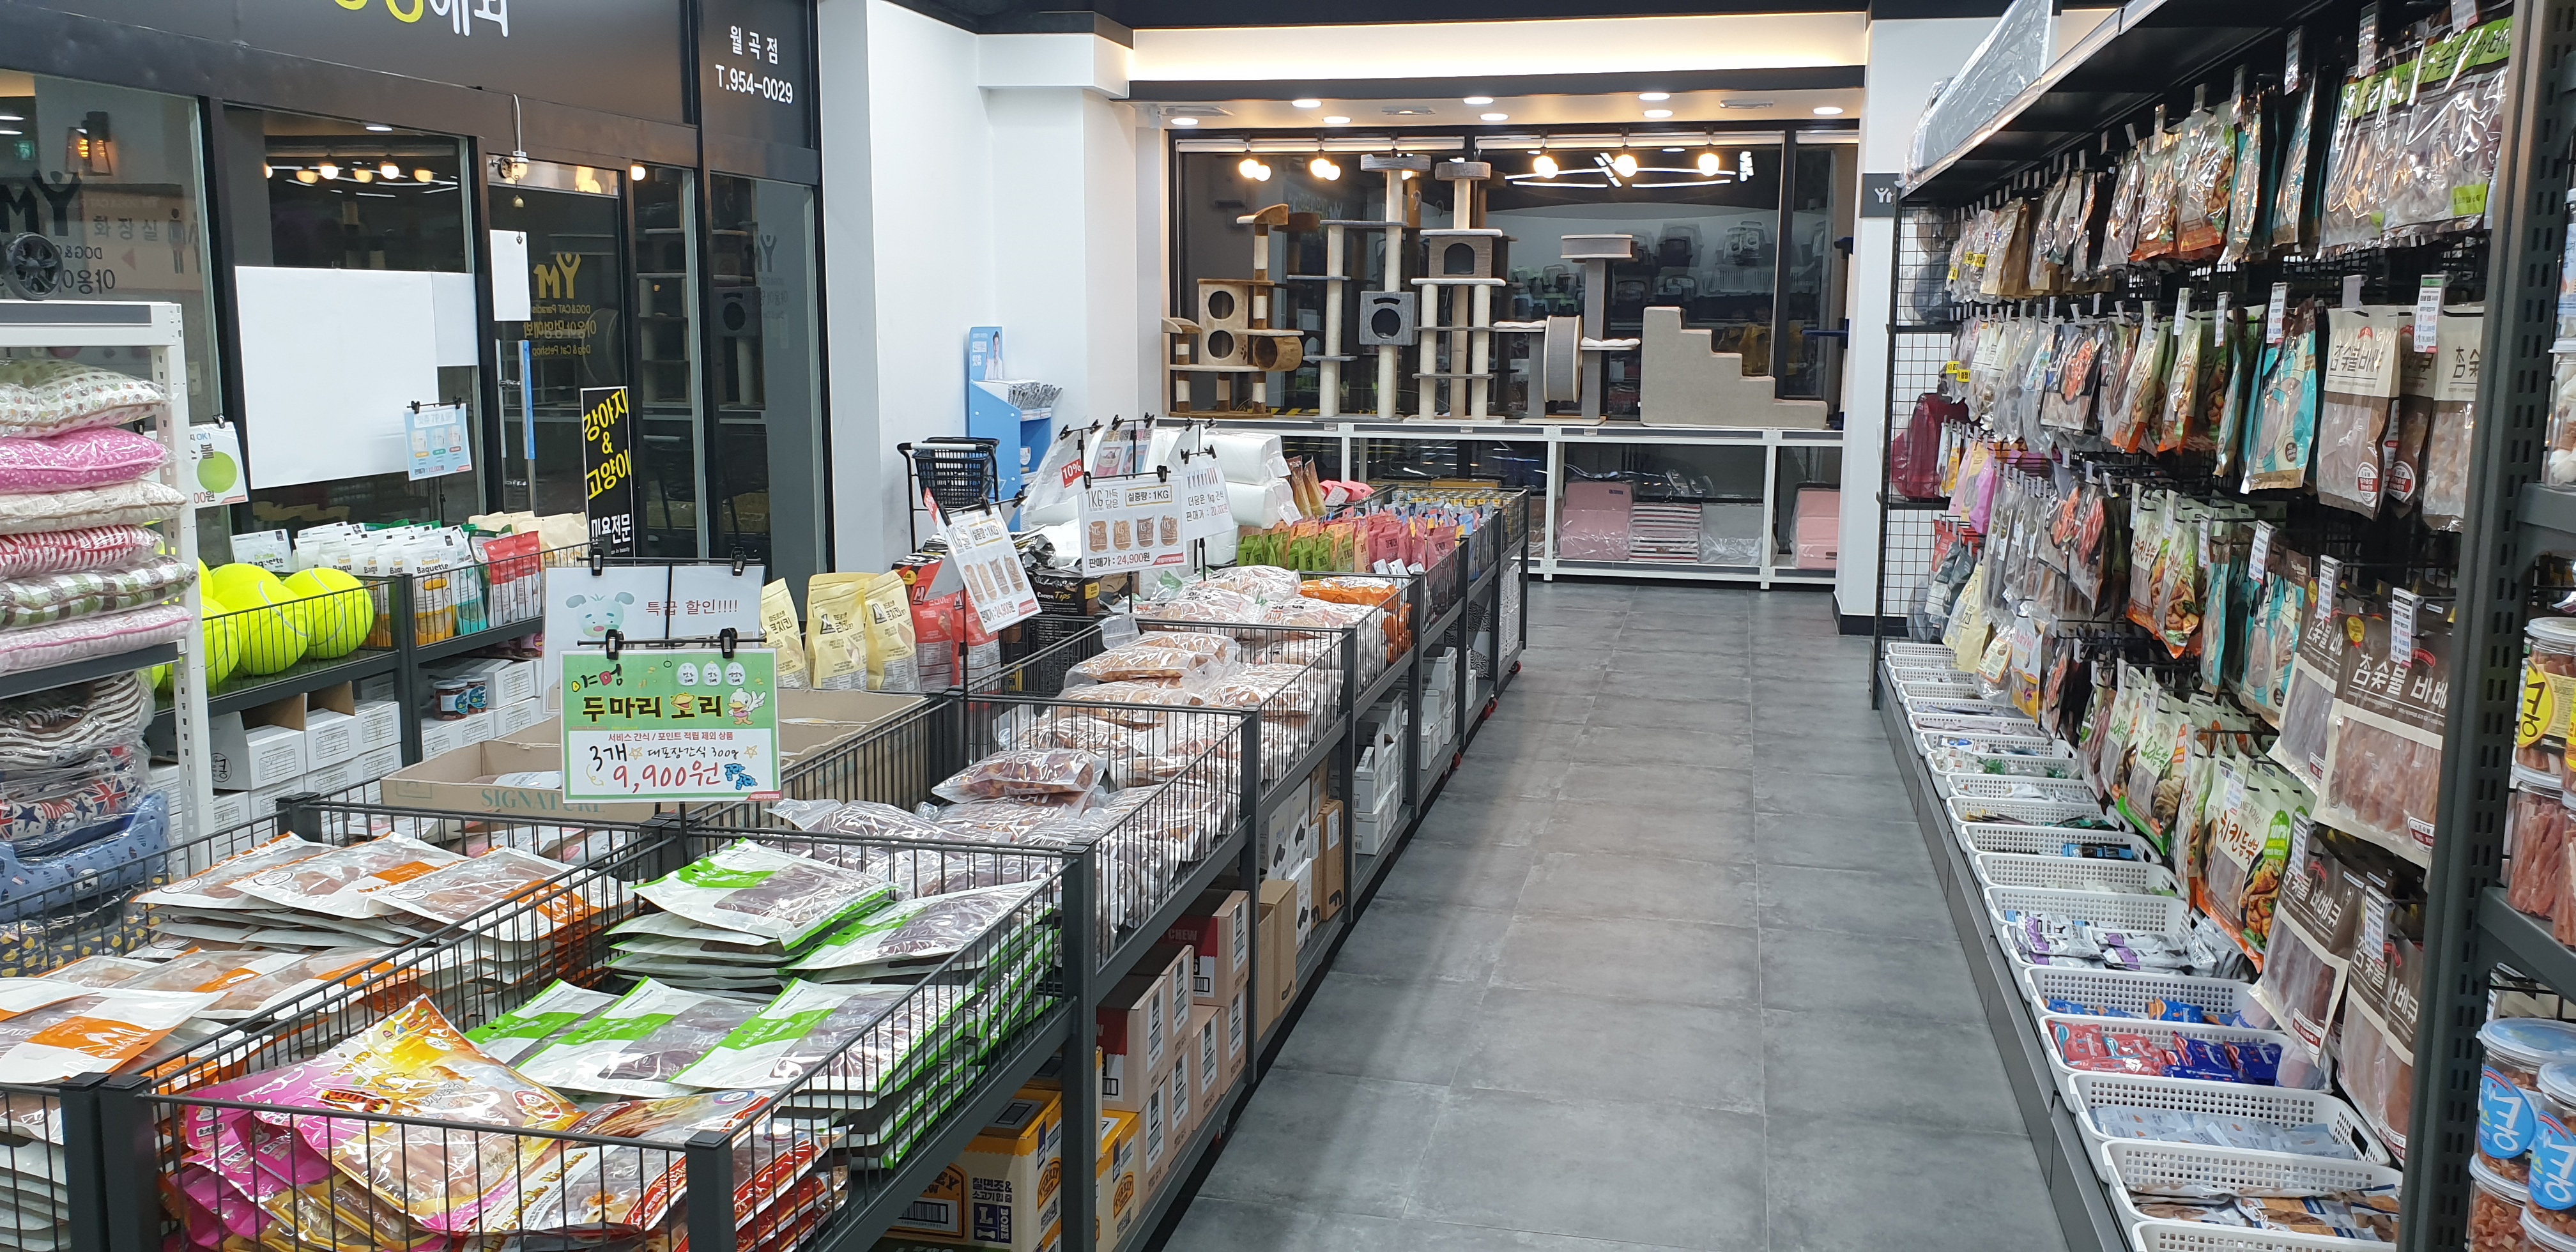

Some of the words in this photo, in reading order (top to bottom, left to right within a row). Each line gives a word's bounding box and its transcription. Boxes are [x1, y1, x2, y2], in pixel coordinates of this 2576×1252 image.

[730, 25, 778, 65] 월곡점
[715, 64, 793, 104] T.954-0029
[2453, 346, 2480, 378] 참숯
[583, 388, 628, 441] 강아지
[601, 431, 614, 448] &
[586, 448, 631, 500] 고양이
[1062, 461, 1082, 479] 10%
[1085, 489, 1103, 508] 1KG
[1128, 491, 1148, 502] 실중량
[1153, 490, 1169, 500] 1KG
[1186, 509, 1205, 522] 판매가
[1089, 556, 1111, 568] 판매가
[1117, 552, 1151, 566] 24,900원
[645, 600, 678, 616] 특급
[685, 598, 739, 615] 할인!!!!
[1054, 590, 1071, 602] Tips
[2352, 652, 2409, 696] 참숯불
[2410, 675, 2449, 709] 바베
[582, 696, 662, 722] 두마리
[670, 692, 723, 719] 오리
[608, 732, 632, 742] 서비스
[634, 732, 651, 742] 간식
[657, 731, 682, 741] 포인트
[684, 731, 700, 741] 적립
[701, 731, 717, 740] 제외
[718, 731, 734, 740] 상품
[588, 742, 628, 772] 3개
[710, 746, 740, 761] 300g
[613, 760, 721, 794] 9,900원
[2309, 888, 2342, 928] 바베큐
[1168, 928, 1199, 942] CHEW
[979, 1206, 993, 1225] L
[1000, 1207, 1009, 1241] BONE
